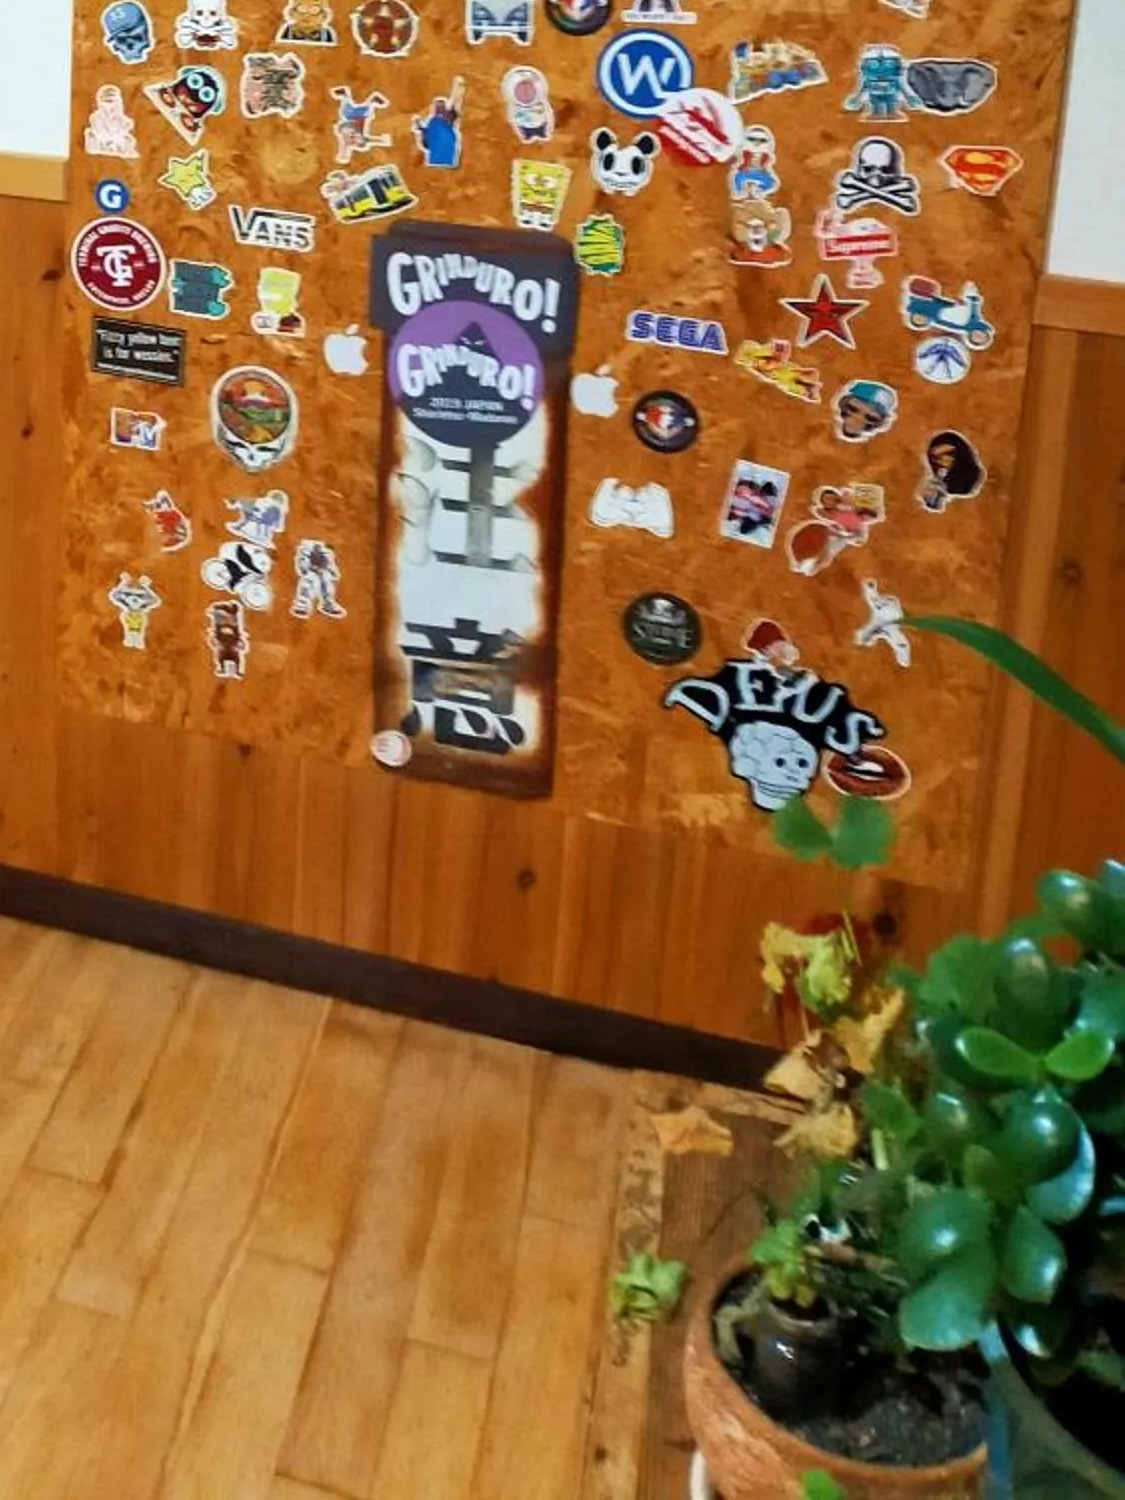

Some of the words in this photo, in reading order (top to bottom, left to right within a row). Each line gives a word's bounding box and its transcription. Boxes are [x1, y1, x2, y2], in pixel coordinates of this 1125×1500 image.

[100, 183, 123, 209] G
[230, 205, 314, 248] VANS
[386, 251, 562, 334] GRINDURO!
[631, 311, 725, 351] SEGA
[396, 342, 537, 412] GRINDURO!
[664, 661, 885, 756] DEUS
